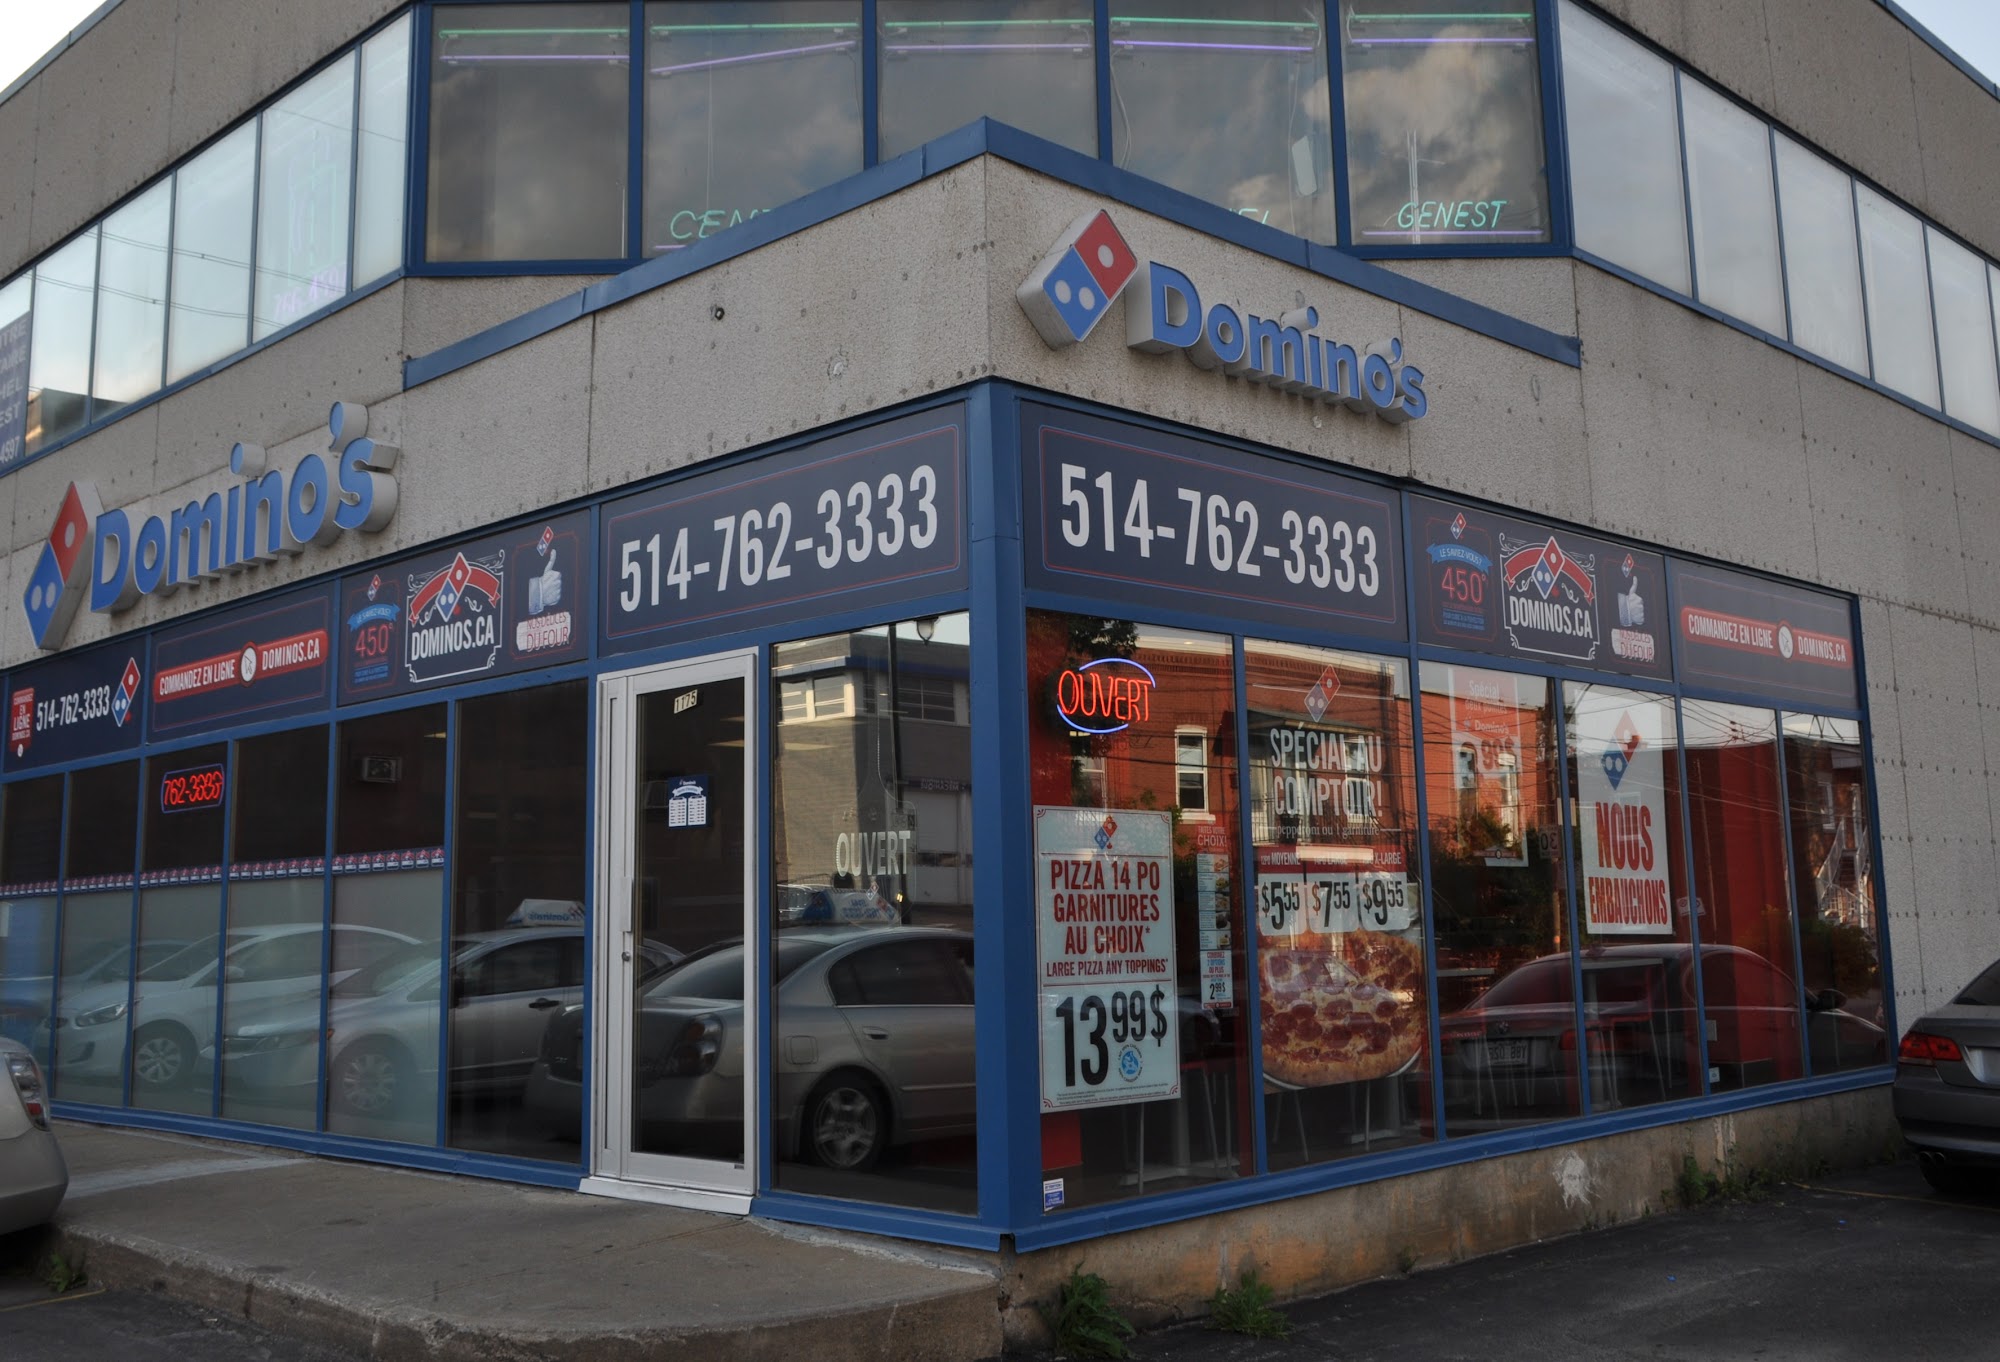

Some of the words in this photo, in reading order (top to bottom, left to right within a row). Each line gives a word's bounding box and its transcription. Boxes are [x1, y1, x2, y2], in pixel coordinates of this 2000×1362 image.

[1397, 201, 1507, 228] GENEST
[1150, 261, 1428, 420] Domino's
[91, 401, 378, 613] Domino's
[620, 465, 938, 612] 514-762-3333
[1061, 462, 1380, 597] 514-762-3333
[1509, 595, 1593, 639] DOMINOS.CA
[1688, 614, 1739, 642] COMMANDEZ
[1740, 625, 1750, 644] EN
[1751, 627, 1774, 649] LIGNE
[262, 638, 320, 670] DOMINOS.CA
[411, 614, 494, 661] DOMINOS.CA
[1798, 636, 1847, 662] DOMINOS.CA
[159, 667, 202, 696] COMMANDEZ
[203, 666, 213, 683] EN
[214, 659, 235, 681] LIGNE
[1058, 670, 1151, 722] OUVERT
[1469, 680, 1500, 699] Spécial
[36, 685, 110, 731] 514-762-3333
[1356, 735, 1382, 773] AU
[1197, 834, 1227, 848] CHOIX!
[1322, 827, 1333, 836] ou
[1342, 824, 1379, 839] garniture
[1596, 802, 1654, 871] NOUS
[836, 830, 911, 877] OUVERT
[1375, 852, 1401, 864] X-LARGE
[1051, 860, 1105, 890] PIZZA
[1111, 860, 1131, 890] 14
[1137, 862, 1160, 891] PO
[1053, 893, 1160, 922] GARNITURES
[1588, 876, 1668, 925] EMBAUCHONS
[1065, 926, 1087, 955] AU
[1046, 962, 1075, 977] LARGE
[1078, 961, 1104, 975] PIZZA
[1106, 960, 1123, 975] ANY
